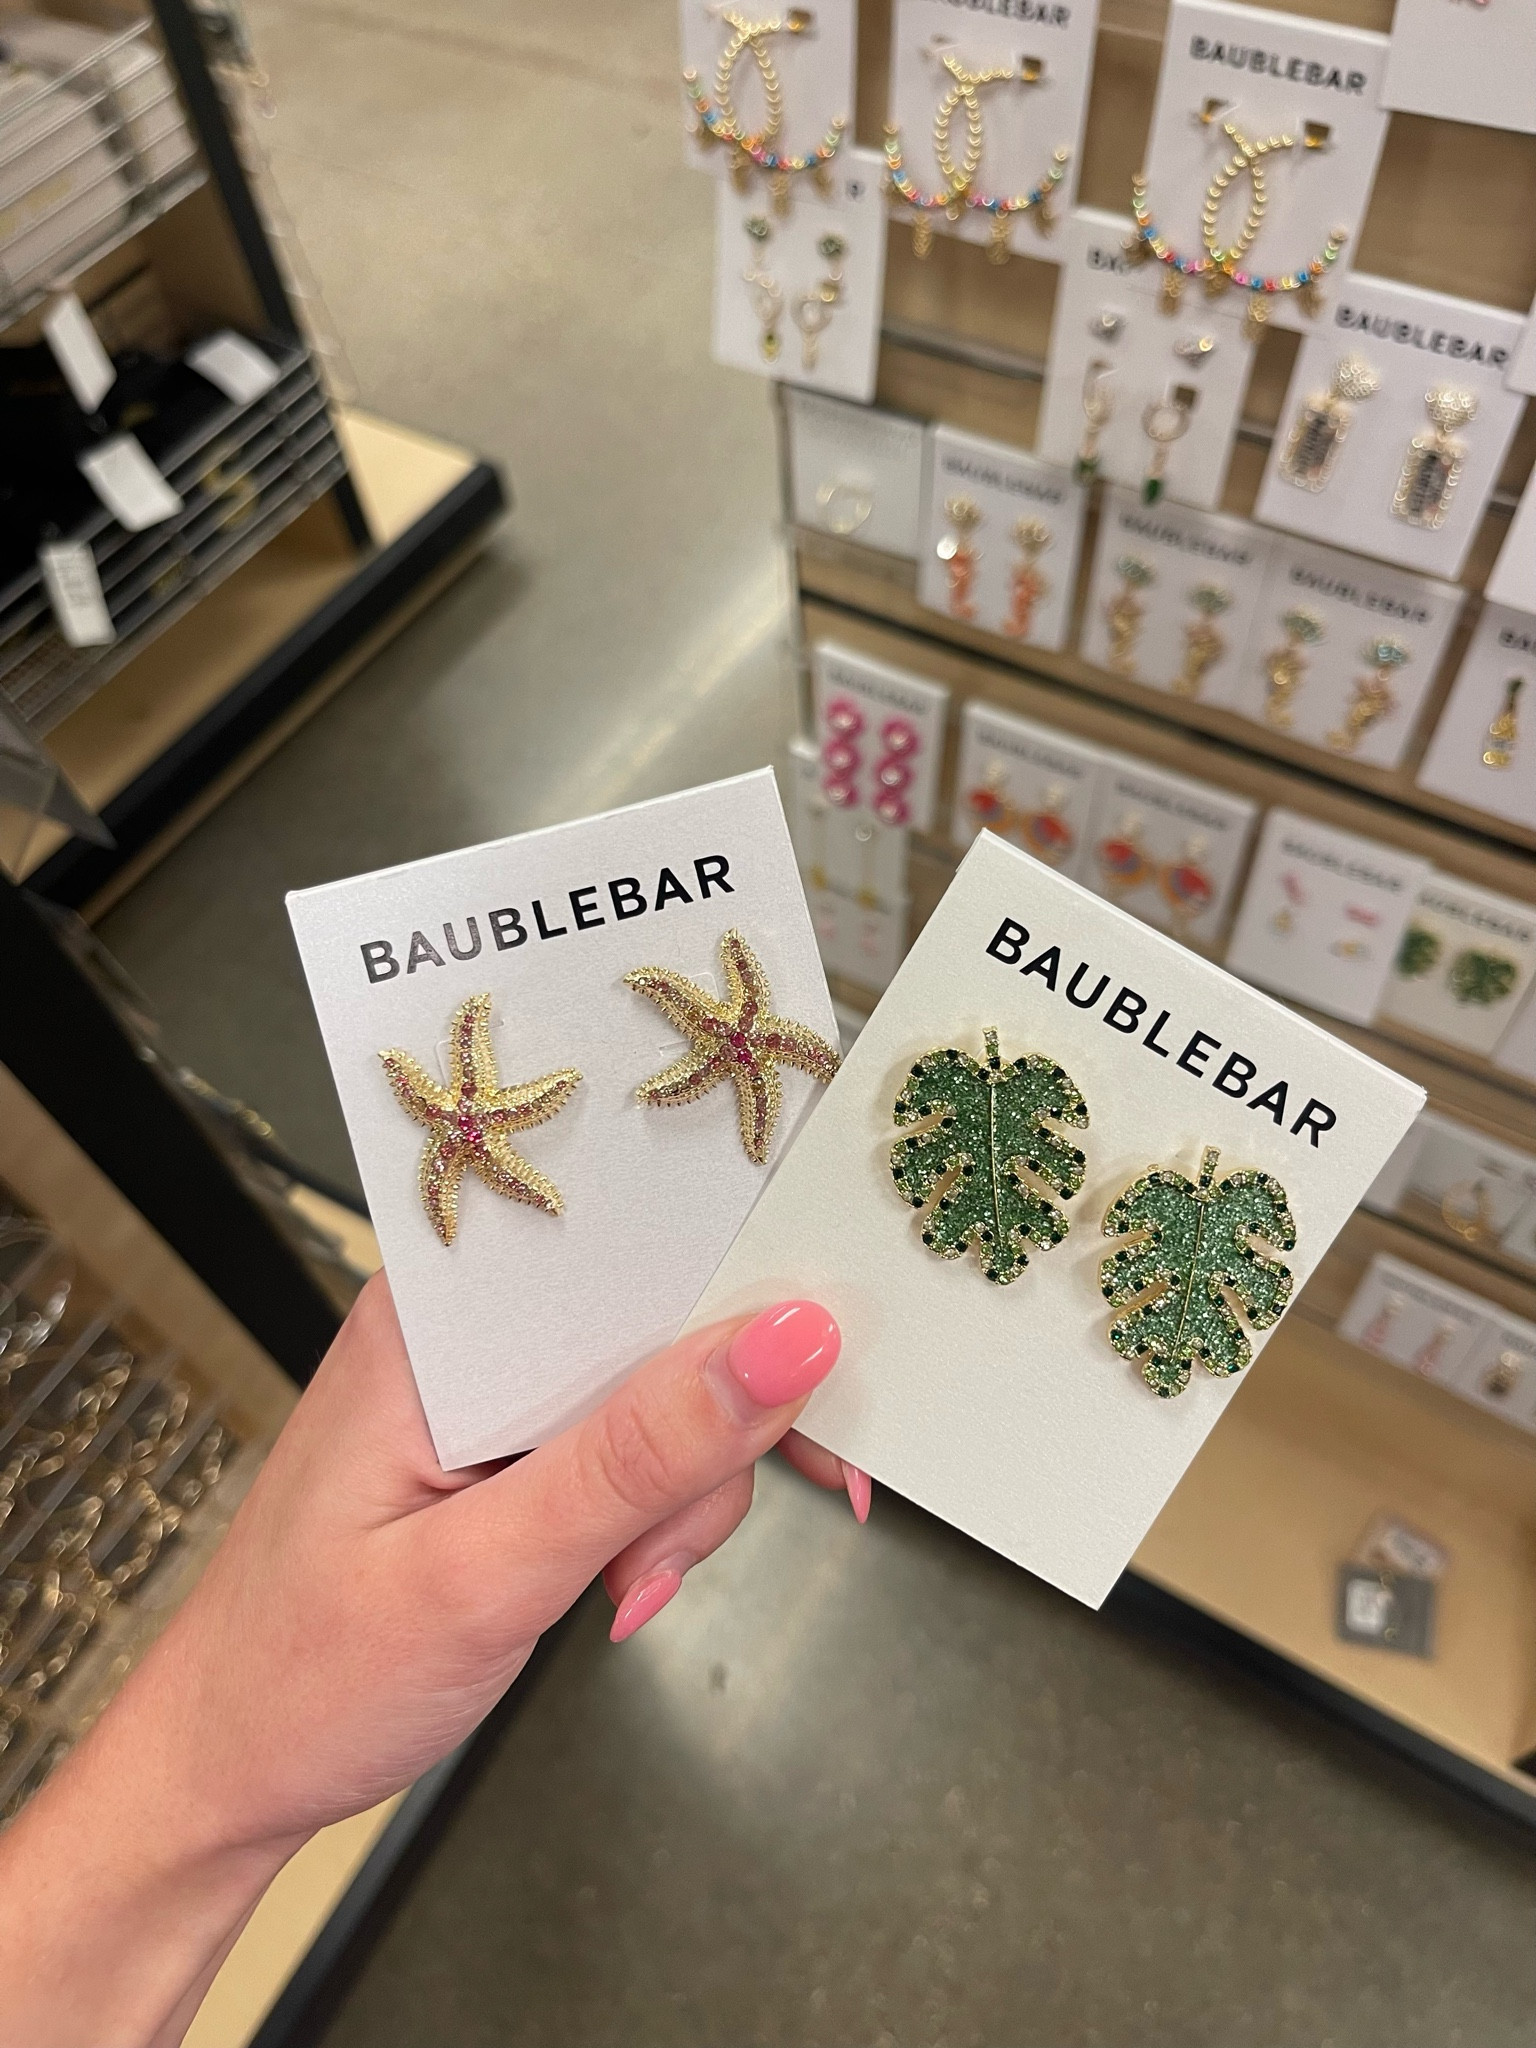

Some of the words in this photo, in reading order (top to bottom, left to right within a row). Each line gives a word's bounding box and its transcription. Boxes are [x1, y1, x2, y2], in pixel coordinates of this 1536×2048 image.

[1190, 36, 1367, 96] BAUBLEBAR
[1335, 305, 1509, 371] BAUBLEBAR
[360, 854, 735, 984] BAUBLEBAR
[985, 916, 1338, 1149] BAUBLEBAR
